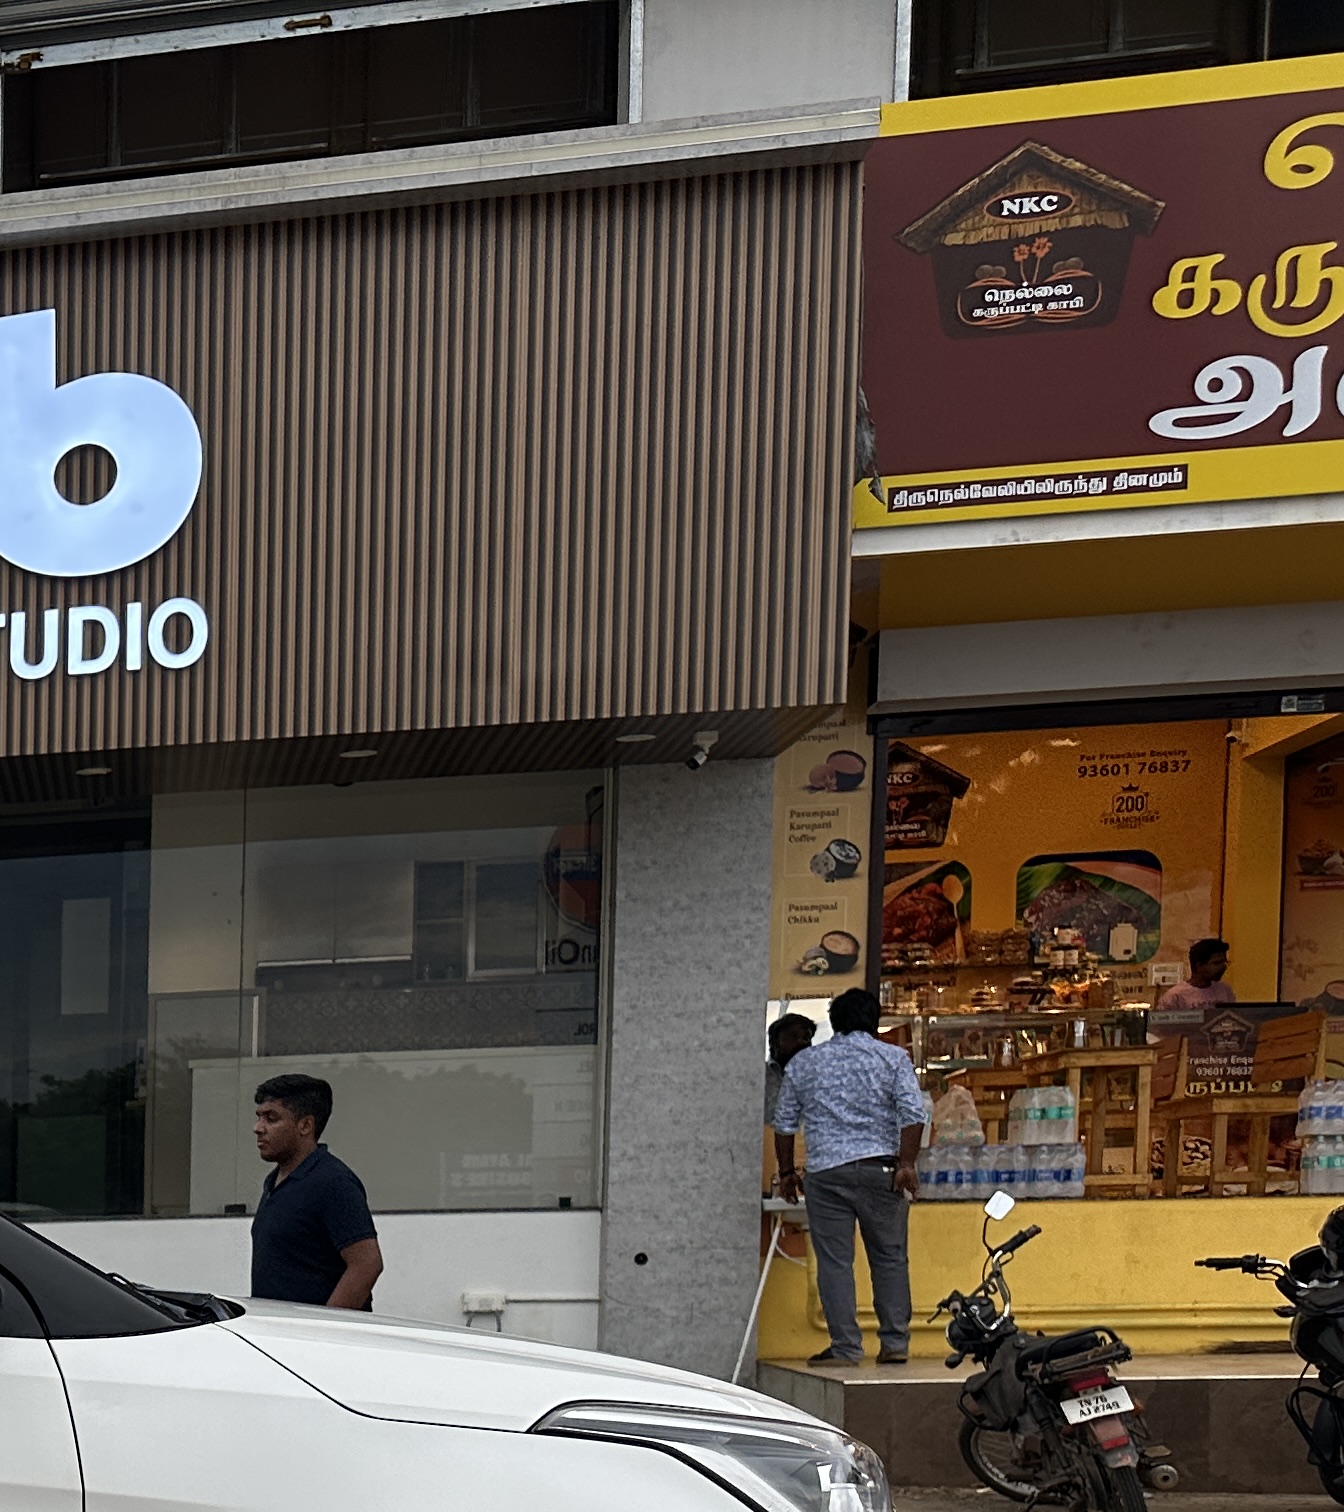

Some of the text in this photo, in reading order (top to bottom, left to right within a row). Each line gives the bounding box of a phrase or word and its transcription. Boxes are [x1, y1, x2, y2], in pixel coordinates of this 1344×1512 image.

[1000, 194, 1059, 216] NKC
[984, 281, 1073, 307] நெல்லை
[972, 296, 1084, 318] கருப்பட்டி காபி
[892, 467, 1184, 510] திருநெல்வேலியிலிருந்து தினமும்
[1077, 760, 1192, 778] 93601 76837
